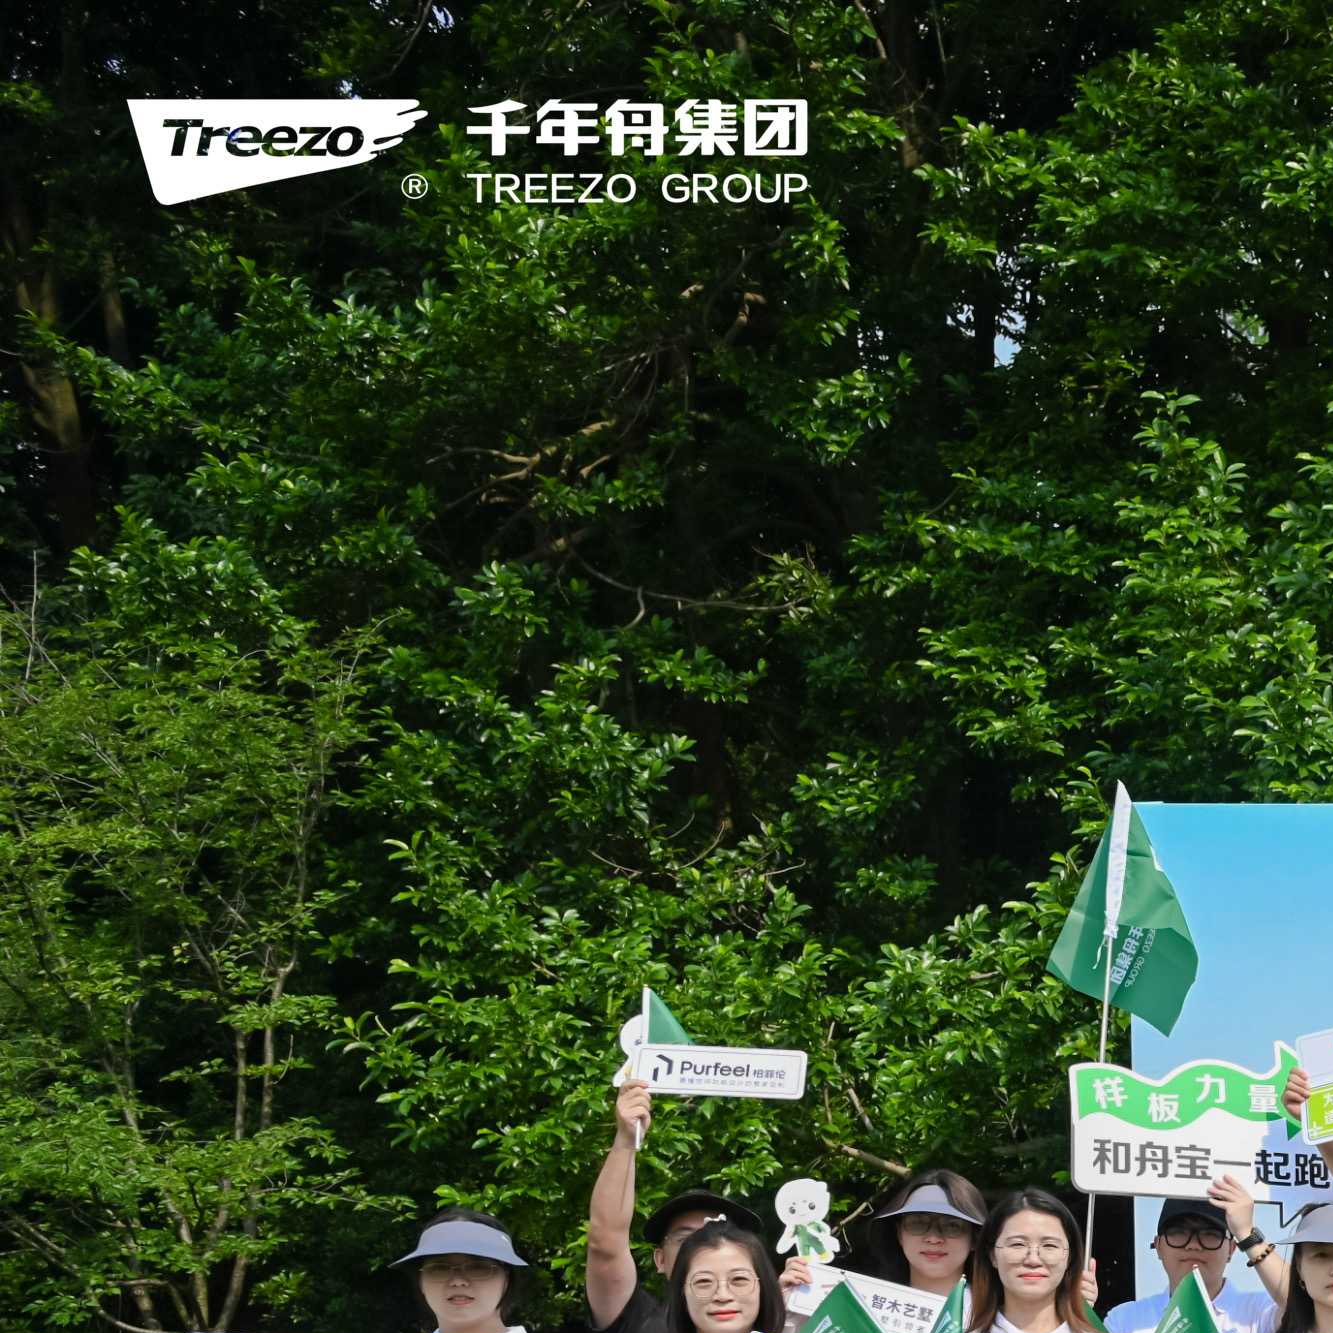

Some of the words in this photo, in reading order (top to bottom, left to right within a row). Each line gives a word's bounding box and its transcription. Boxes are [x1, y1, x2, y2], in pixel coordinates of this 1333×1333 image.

[680, 1061, 751, 1077] Purfeel
[1092, 1073, 1281, 1124] 样板力量
[871, 1294, 935, 1323] 智木艺墅
